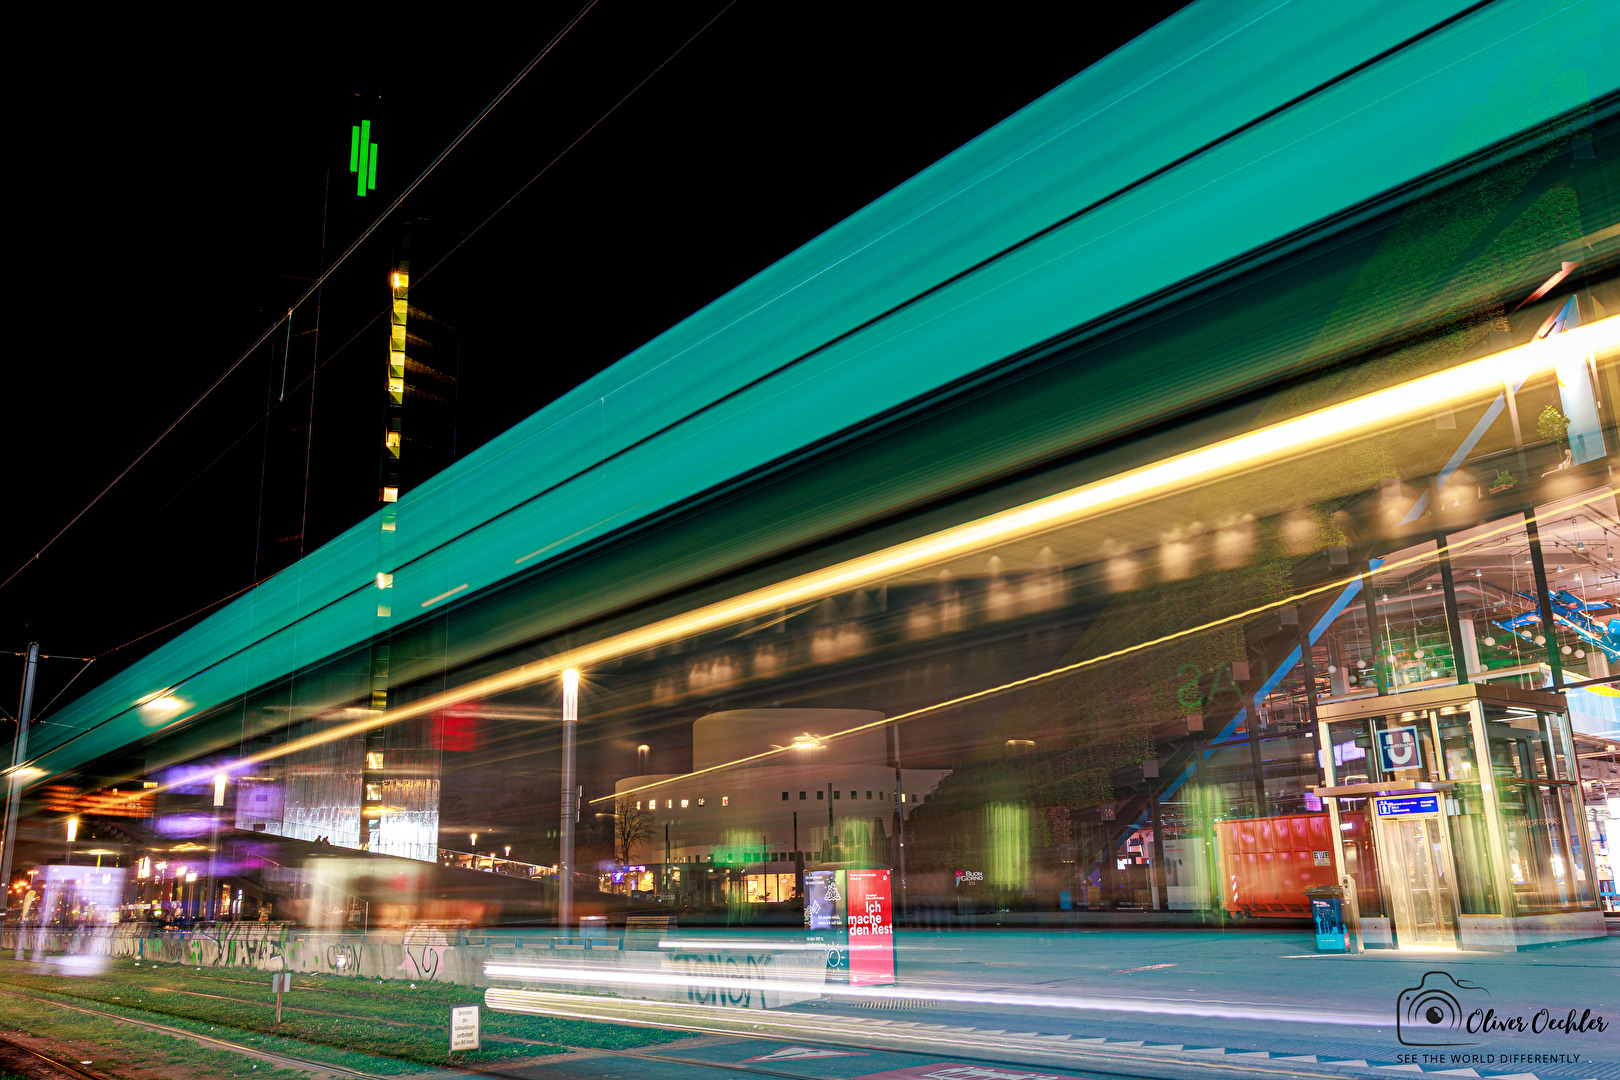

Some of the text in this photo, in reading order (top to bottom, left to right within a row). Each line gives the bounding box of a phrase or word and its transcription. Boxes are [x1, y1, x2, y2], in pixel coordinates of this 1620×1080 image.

[1385, 732, 1412, 765] U
[865, 901, 881, 913] Ich
[848, 912, 882, 924] mache
[849, 923, 893, 936] den Rest
